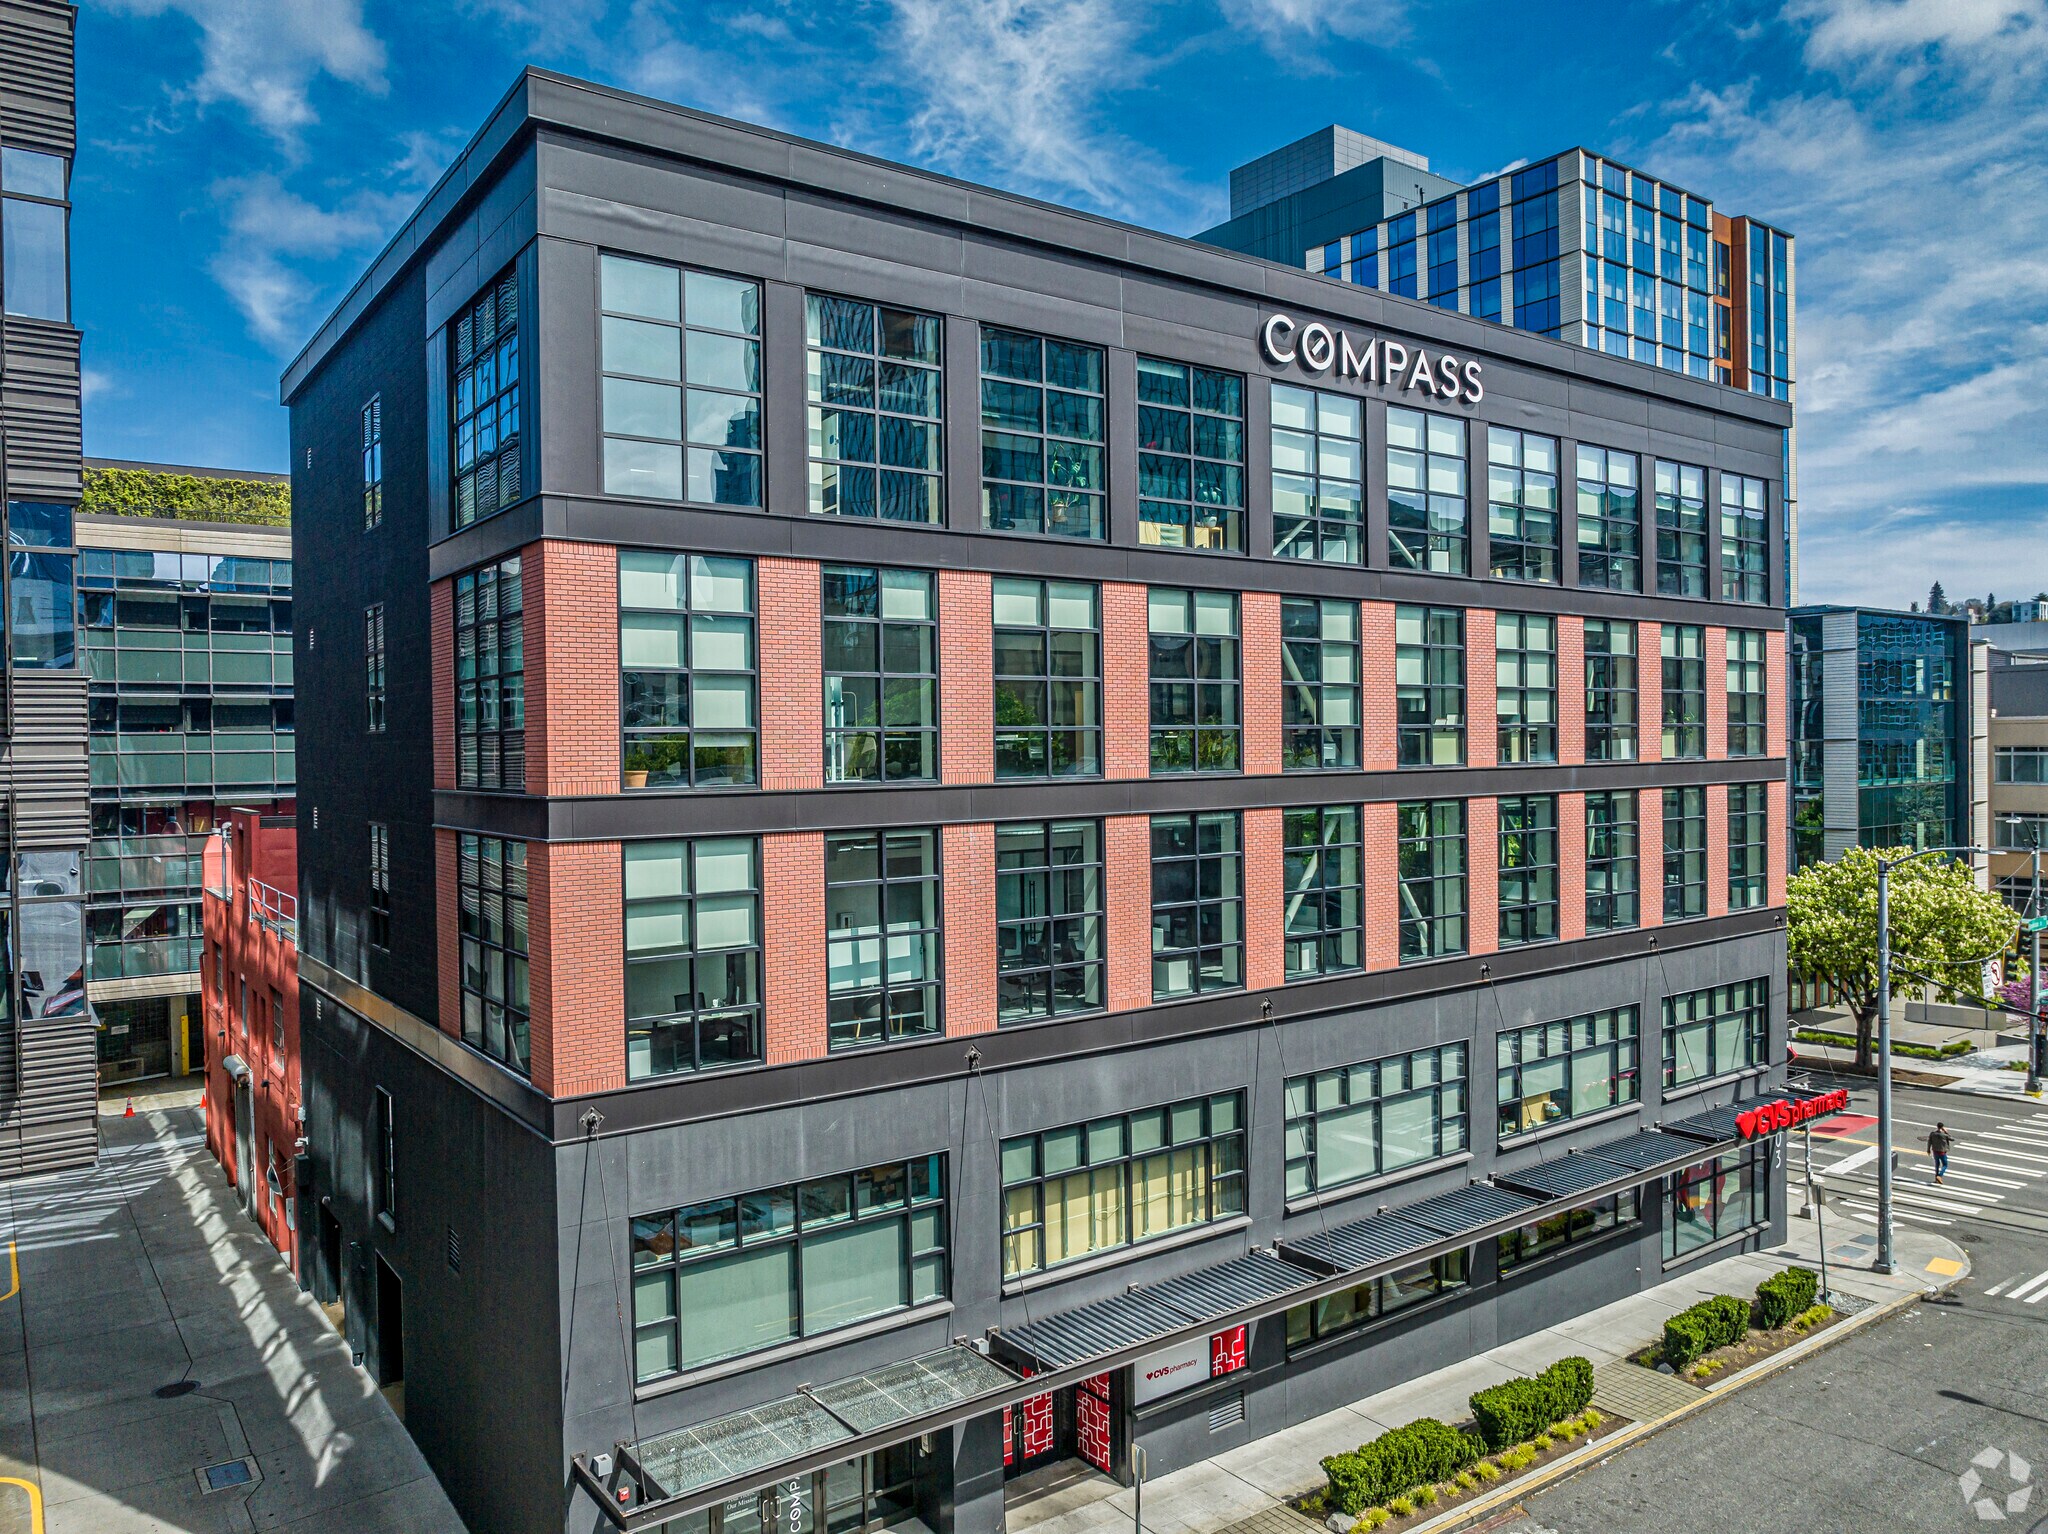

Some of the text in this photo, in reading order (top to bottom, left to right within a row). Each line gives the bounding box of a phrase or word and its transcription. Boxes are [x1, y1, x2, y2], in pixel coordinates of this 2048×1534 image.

[1261, 314, 1484, 403] COMPASS
[1754, 1089, 1848, 1135] CVS pharmacy
[1154, 1359, 1197, 1378] CVS pharmacy
[790, 1477, 801, 1532] COMP
